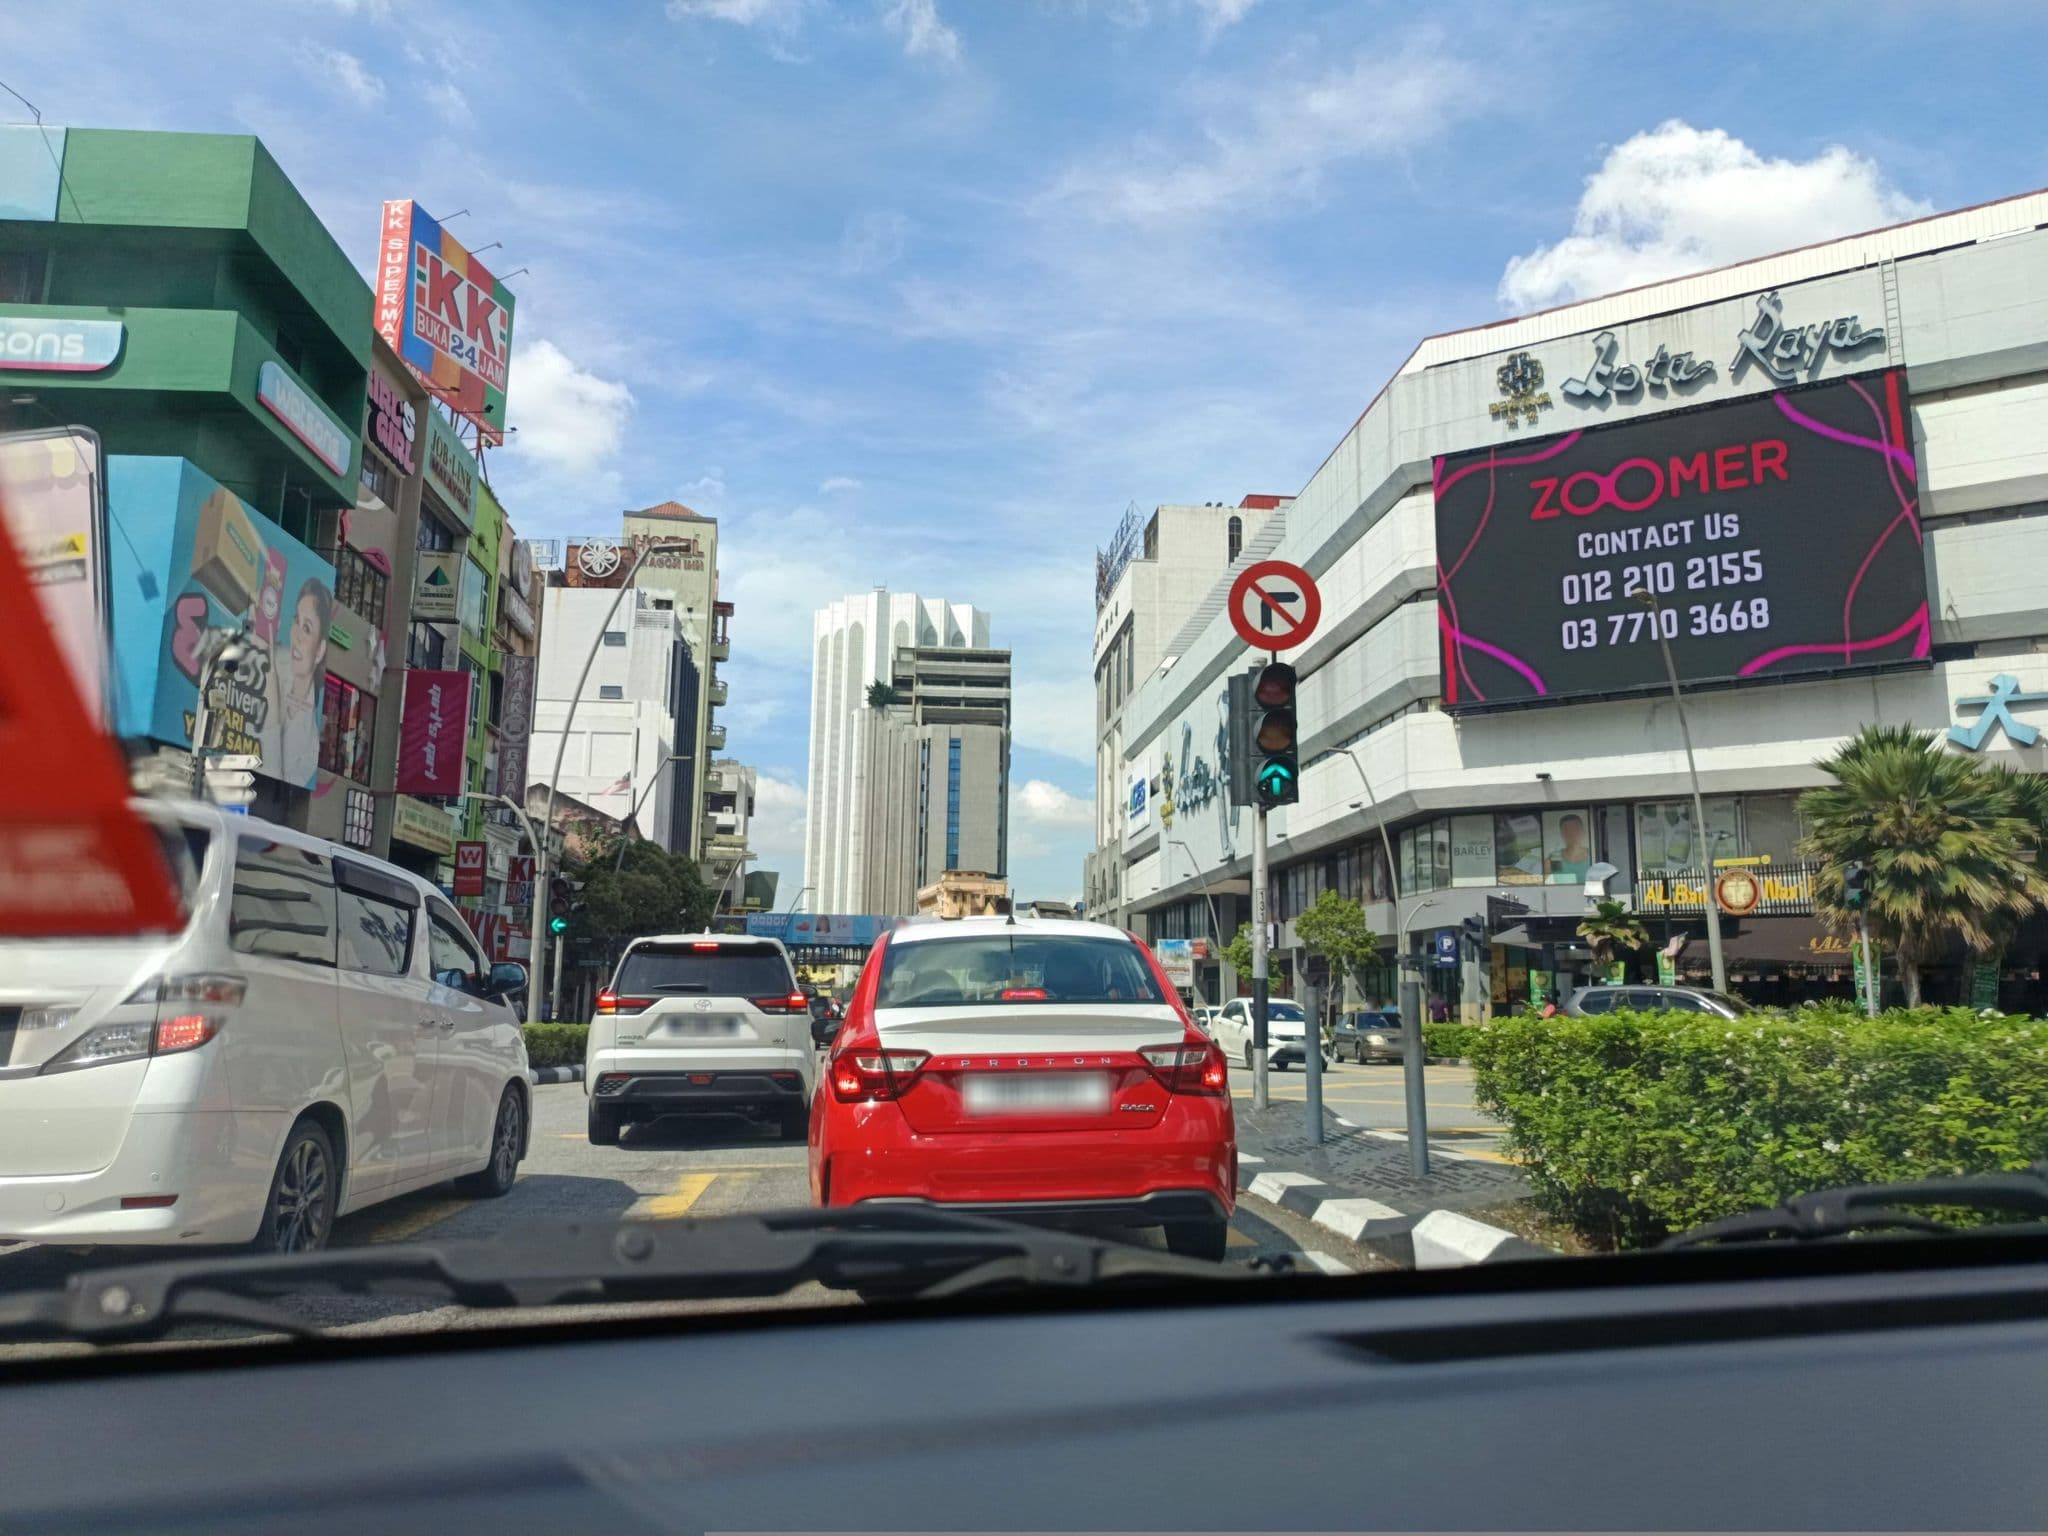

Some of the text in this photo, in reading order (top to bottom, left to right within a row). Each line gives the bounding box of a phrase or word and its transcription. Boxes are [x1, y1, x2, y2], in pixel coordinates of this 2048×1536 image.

[429, 255, 498, 356] KK
[0, 330, 84, 358] ons
[415, 312, 449, 353] BUKA
[450, 333, 478, 369] 24
[479, 354, 505, 389] JAM
[1728, 290, 1884, 382] Raya
[376, 410, 416, 476] GIRL
[1528, 439, 1789, 521] ZOOMER
[1577, 519, 1695, 559] CONTACT
[1562, 549, 1764, 606] 012 210 2155
[1561, 597, 1771, 650] 03 7710 3668
[213, 678, 266, 726] elivery
[225, 730, 262, 756] SAMA
[1453, 845, 1491, 857] BARLEY
[961, 1056, 1112, 1068] PROTON
[1119, 1103, 1155, 1112] SAGA
